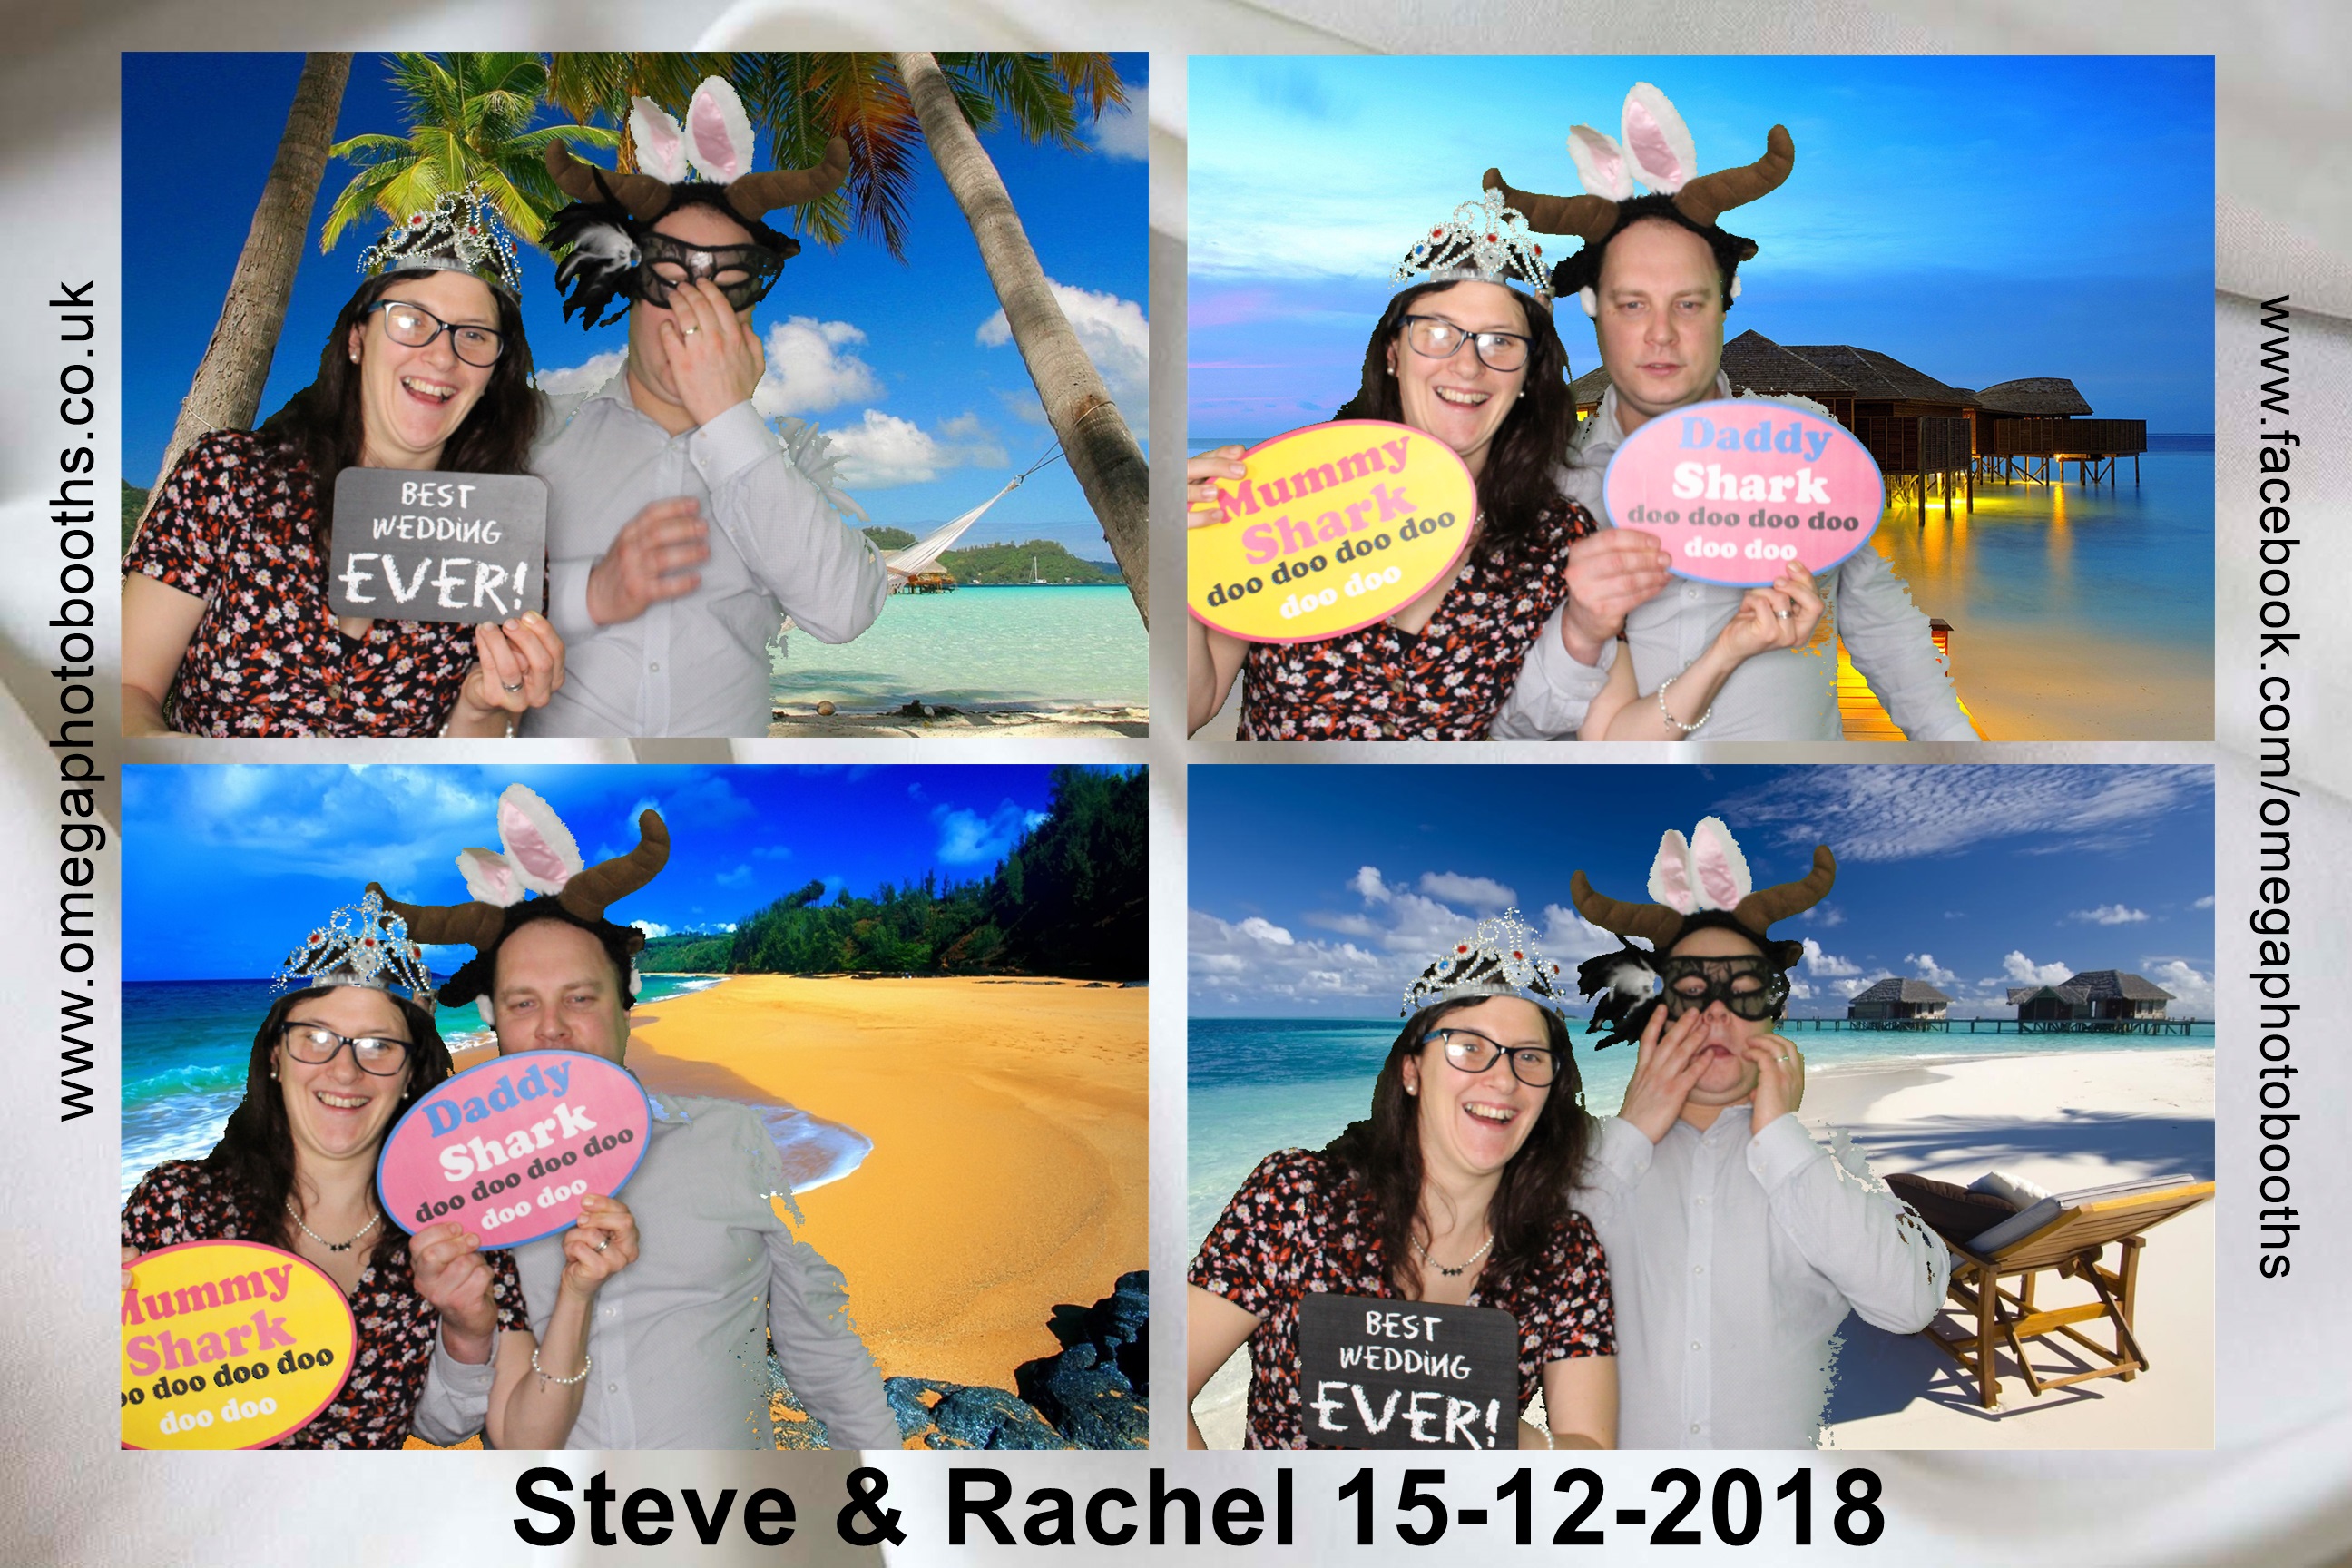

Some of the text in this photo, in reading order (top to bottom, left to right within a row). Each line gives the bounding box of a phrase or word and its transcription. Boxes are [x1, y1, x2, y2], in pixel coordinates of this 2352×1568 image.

[1680, 416, 1833, 463] Daddy
[401, 481, 477, 509] BEST
[1217, 436, 1411, 524] Mummy
[1671, 461, 1831, 505] Shark
[1240, 483, 1418, 565] Shark
[1627, 504, 1859, 532] doo doo doo doo
[1206, 511, 1455, 607] doo doo doo doo
[1683, 535, 1798, 562] doo doo
[338, 552, 528, 615] EVER!
[1279, 565, 1402, 620] doo doo
[421, 1060, 572, 1138] Daddy
[438, 1102, 597, 1182] Shark
[415, 1128, 634, 1223] doo doo doo doo
[480, 1179, 588, 1230] doo doo
[125, 1309, 297, 1377] Shark
[1365, 1310, 1443, 1342] BEST
[152, 1376, 207, 1400] doo
[213, 1363, 270, 1387] doo
[277, 1348, 334, 1375] doo
[159, 1396, 278, 1436] doo doo
[1309, 1380, 1501, 1450] EVER!
